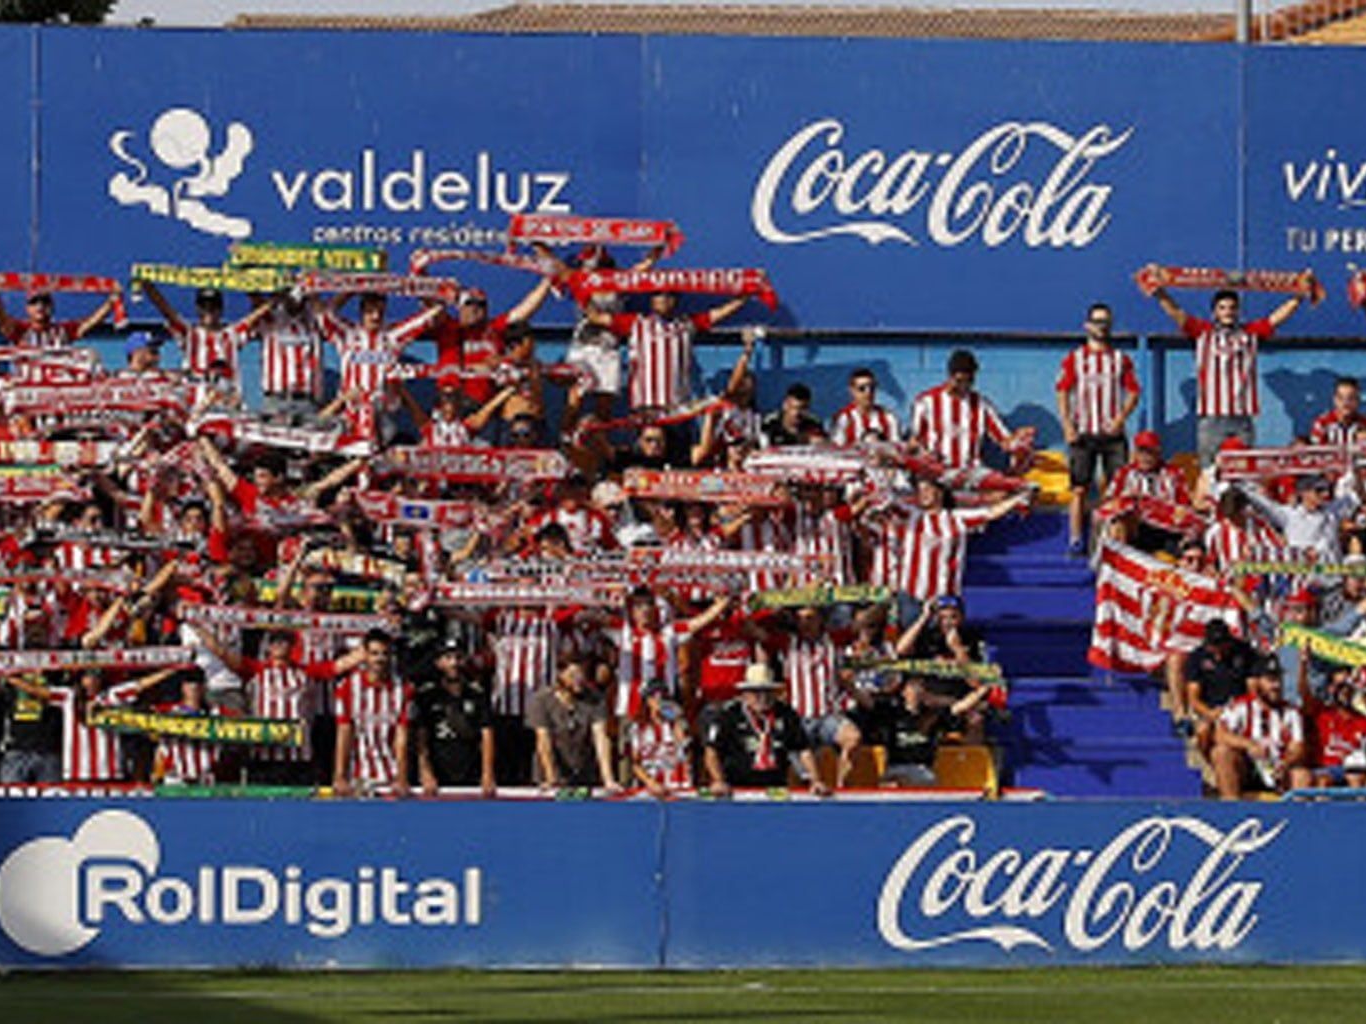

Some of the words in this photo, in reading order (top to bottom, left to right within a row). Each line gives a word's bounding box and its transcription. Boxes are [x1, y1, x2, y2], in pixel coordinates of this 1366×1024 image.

[271, 149, 572, 214] valdeluz
[752, 119, 1135, 248] Coca-Cola
[313, 225, 403, 244] centros
[1287, 227, 1317, 252] TU
[83, 865, 482, 938] RolDigital
[877, 814, 1288, 953] Coca-Cola
